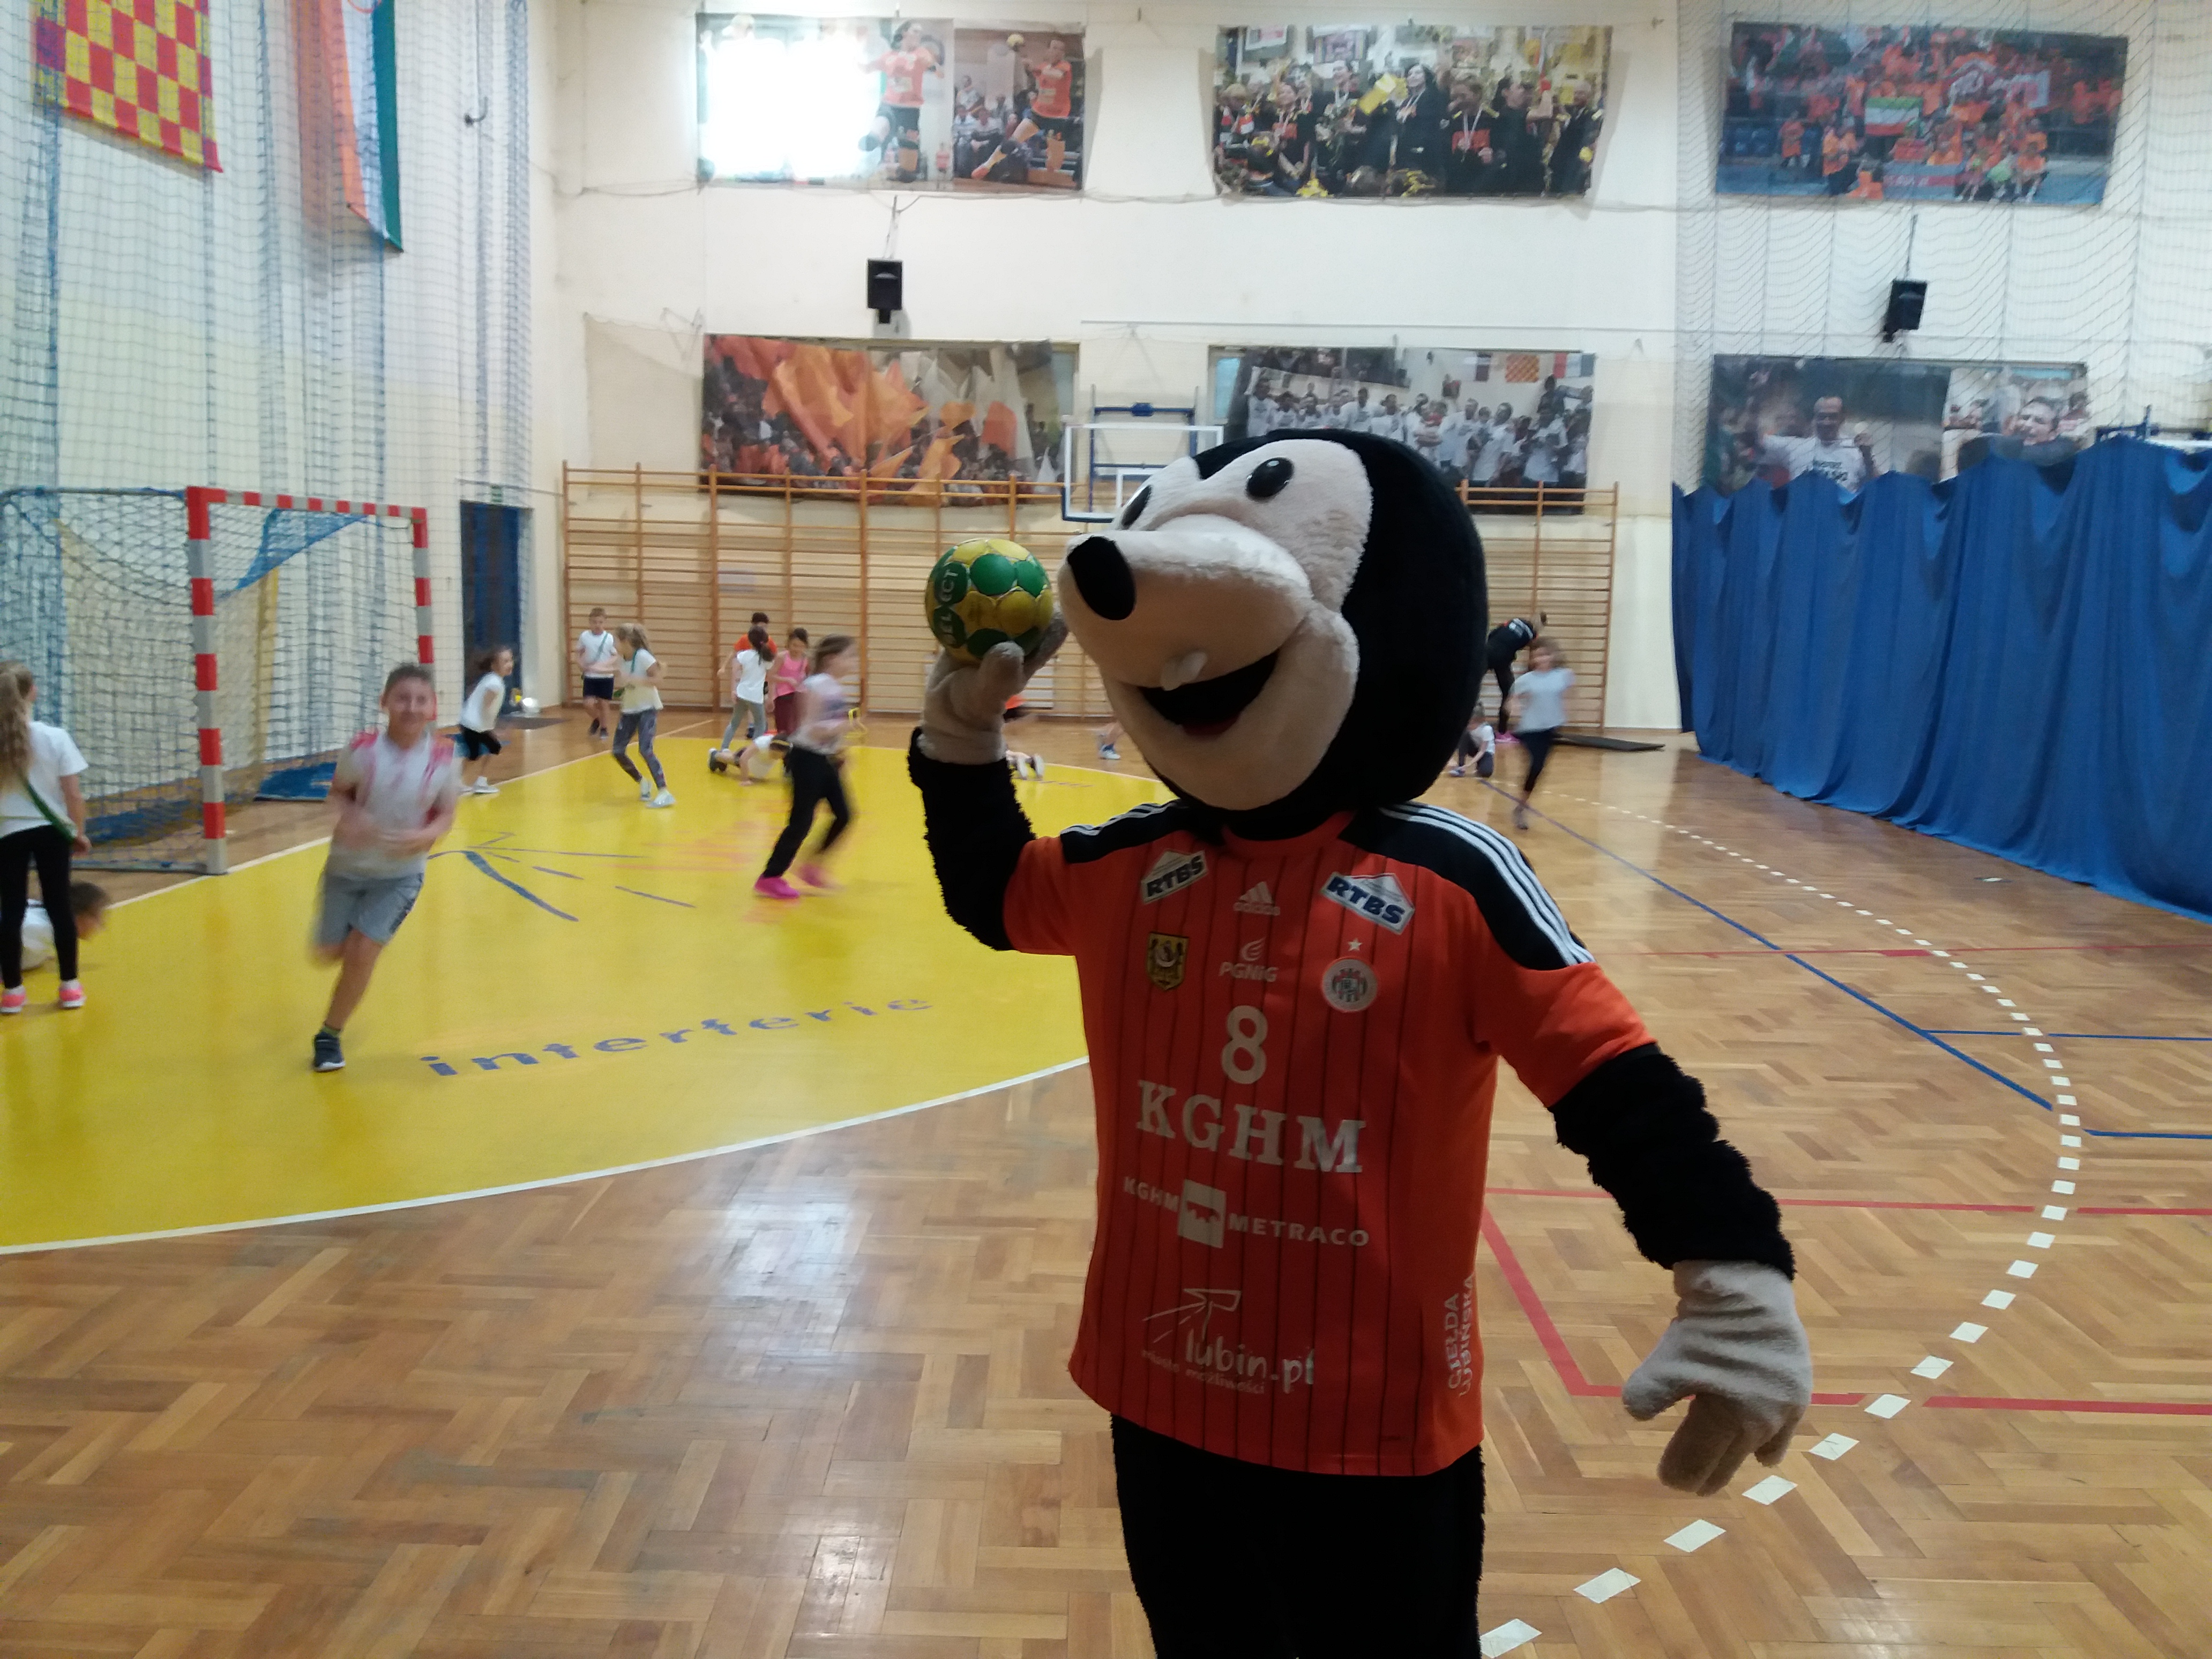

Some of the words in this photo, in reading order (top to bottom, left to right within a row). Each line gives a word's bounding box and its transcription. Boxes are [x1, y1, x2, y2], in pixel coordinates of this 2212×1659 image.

[1147, 855, 1204, 897] RTBS
[1326, 876, 1404, 926] RTBS
[1221, 1005, 1268, 1085] 8
[1136, 1079, 1366, 1174] KGHM
[1122, 1176, 1179, 1213] KGHM
[1227, 1213, 1370, 1247] METRACO
[1184, 1328, 1314, 1394] lubin.pl
